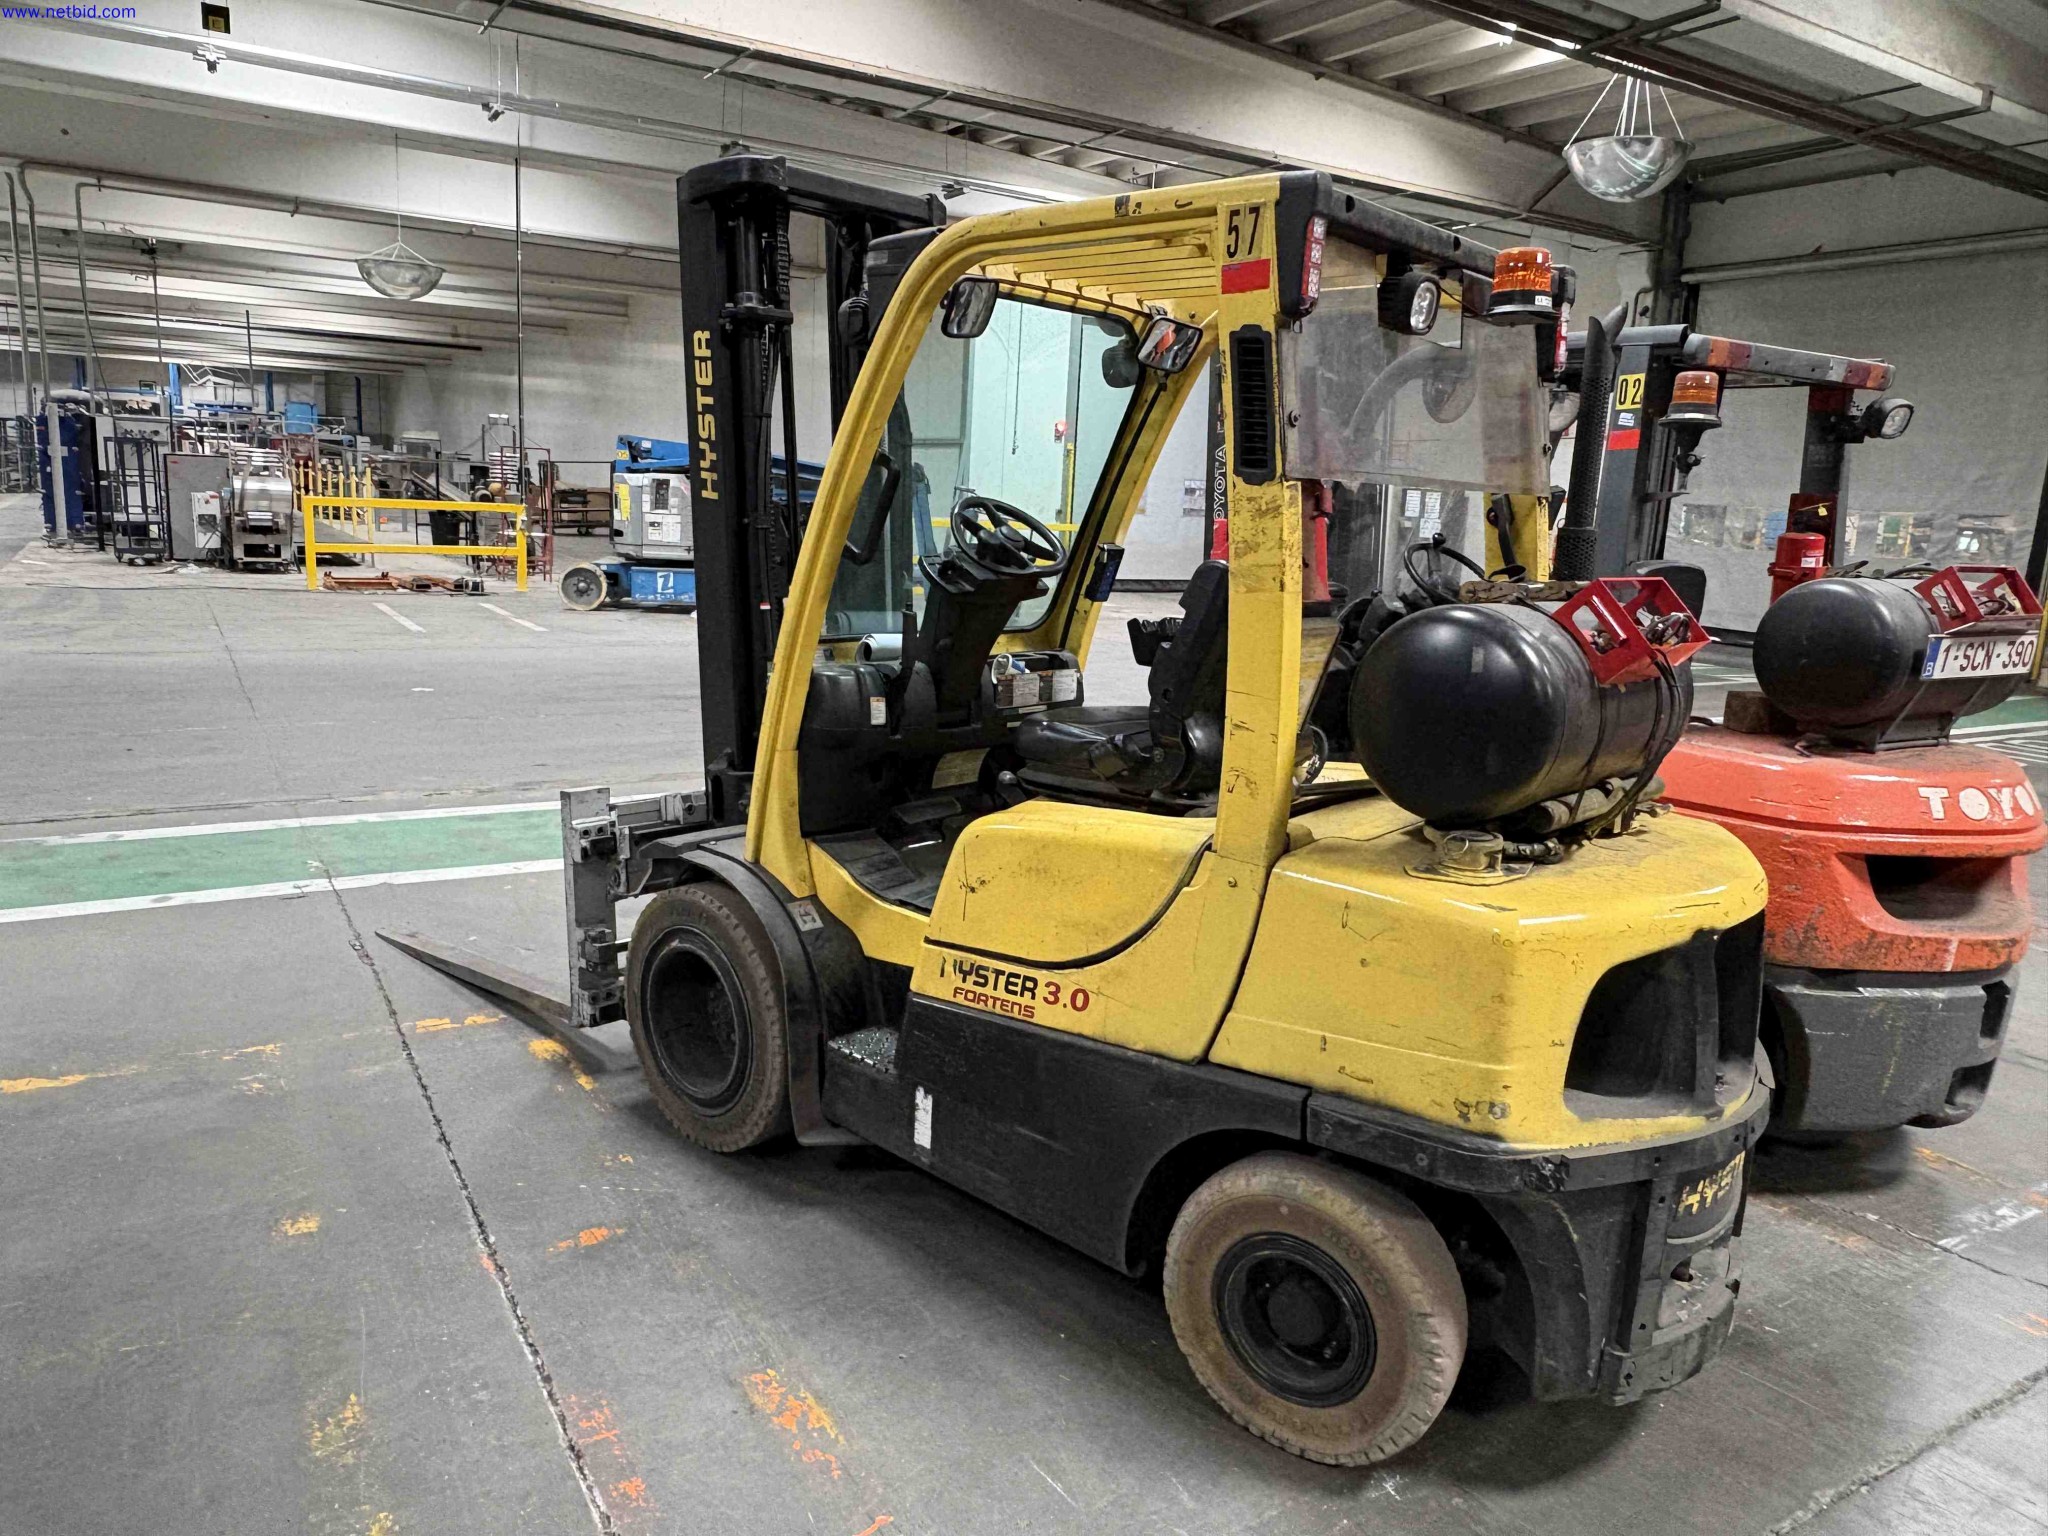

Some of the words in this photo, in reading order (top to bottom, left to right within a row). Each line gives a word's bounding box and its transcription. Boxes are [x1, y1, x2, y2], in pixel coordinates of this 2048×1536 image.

[1226, 206, 1260, 258] 57
[1618, 378, 1642, 406] 02
[693, 330, 719, 500] HYSTER
[1213, 444, 1227, 521] OYOTA
[953, 986, 1036, 1019] FORTENS
[1043, 981, 1090, 1012] 3.0
